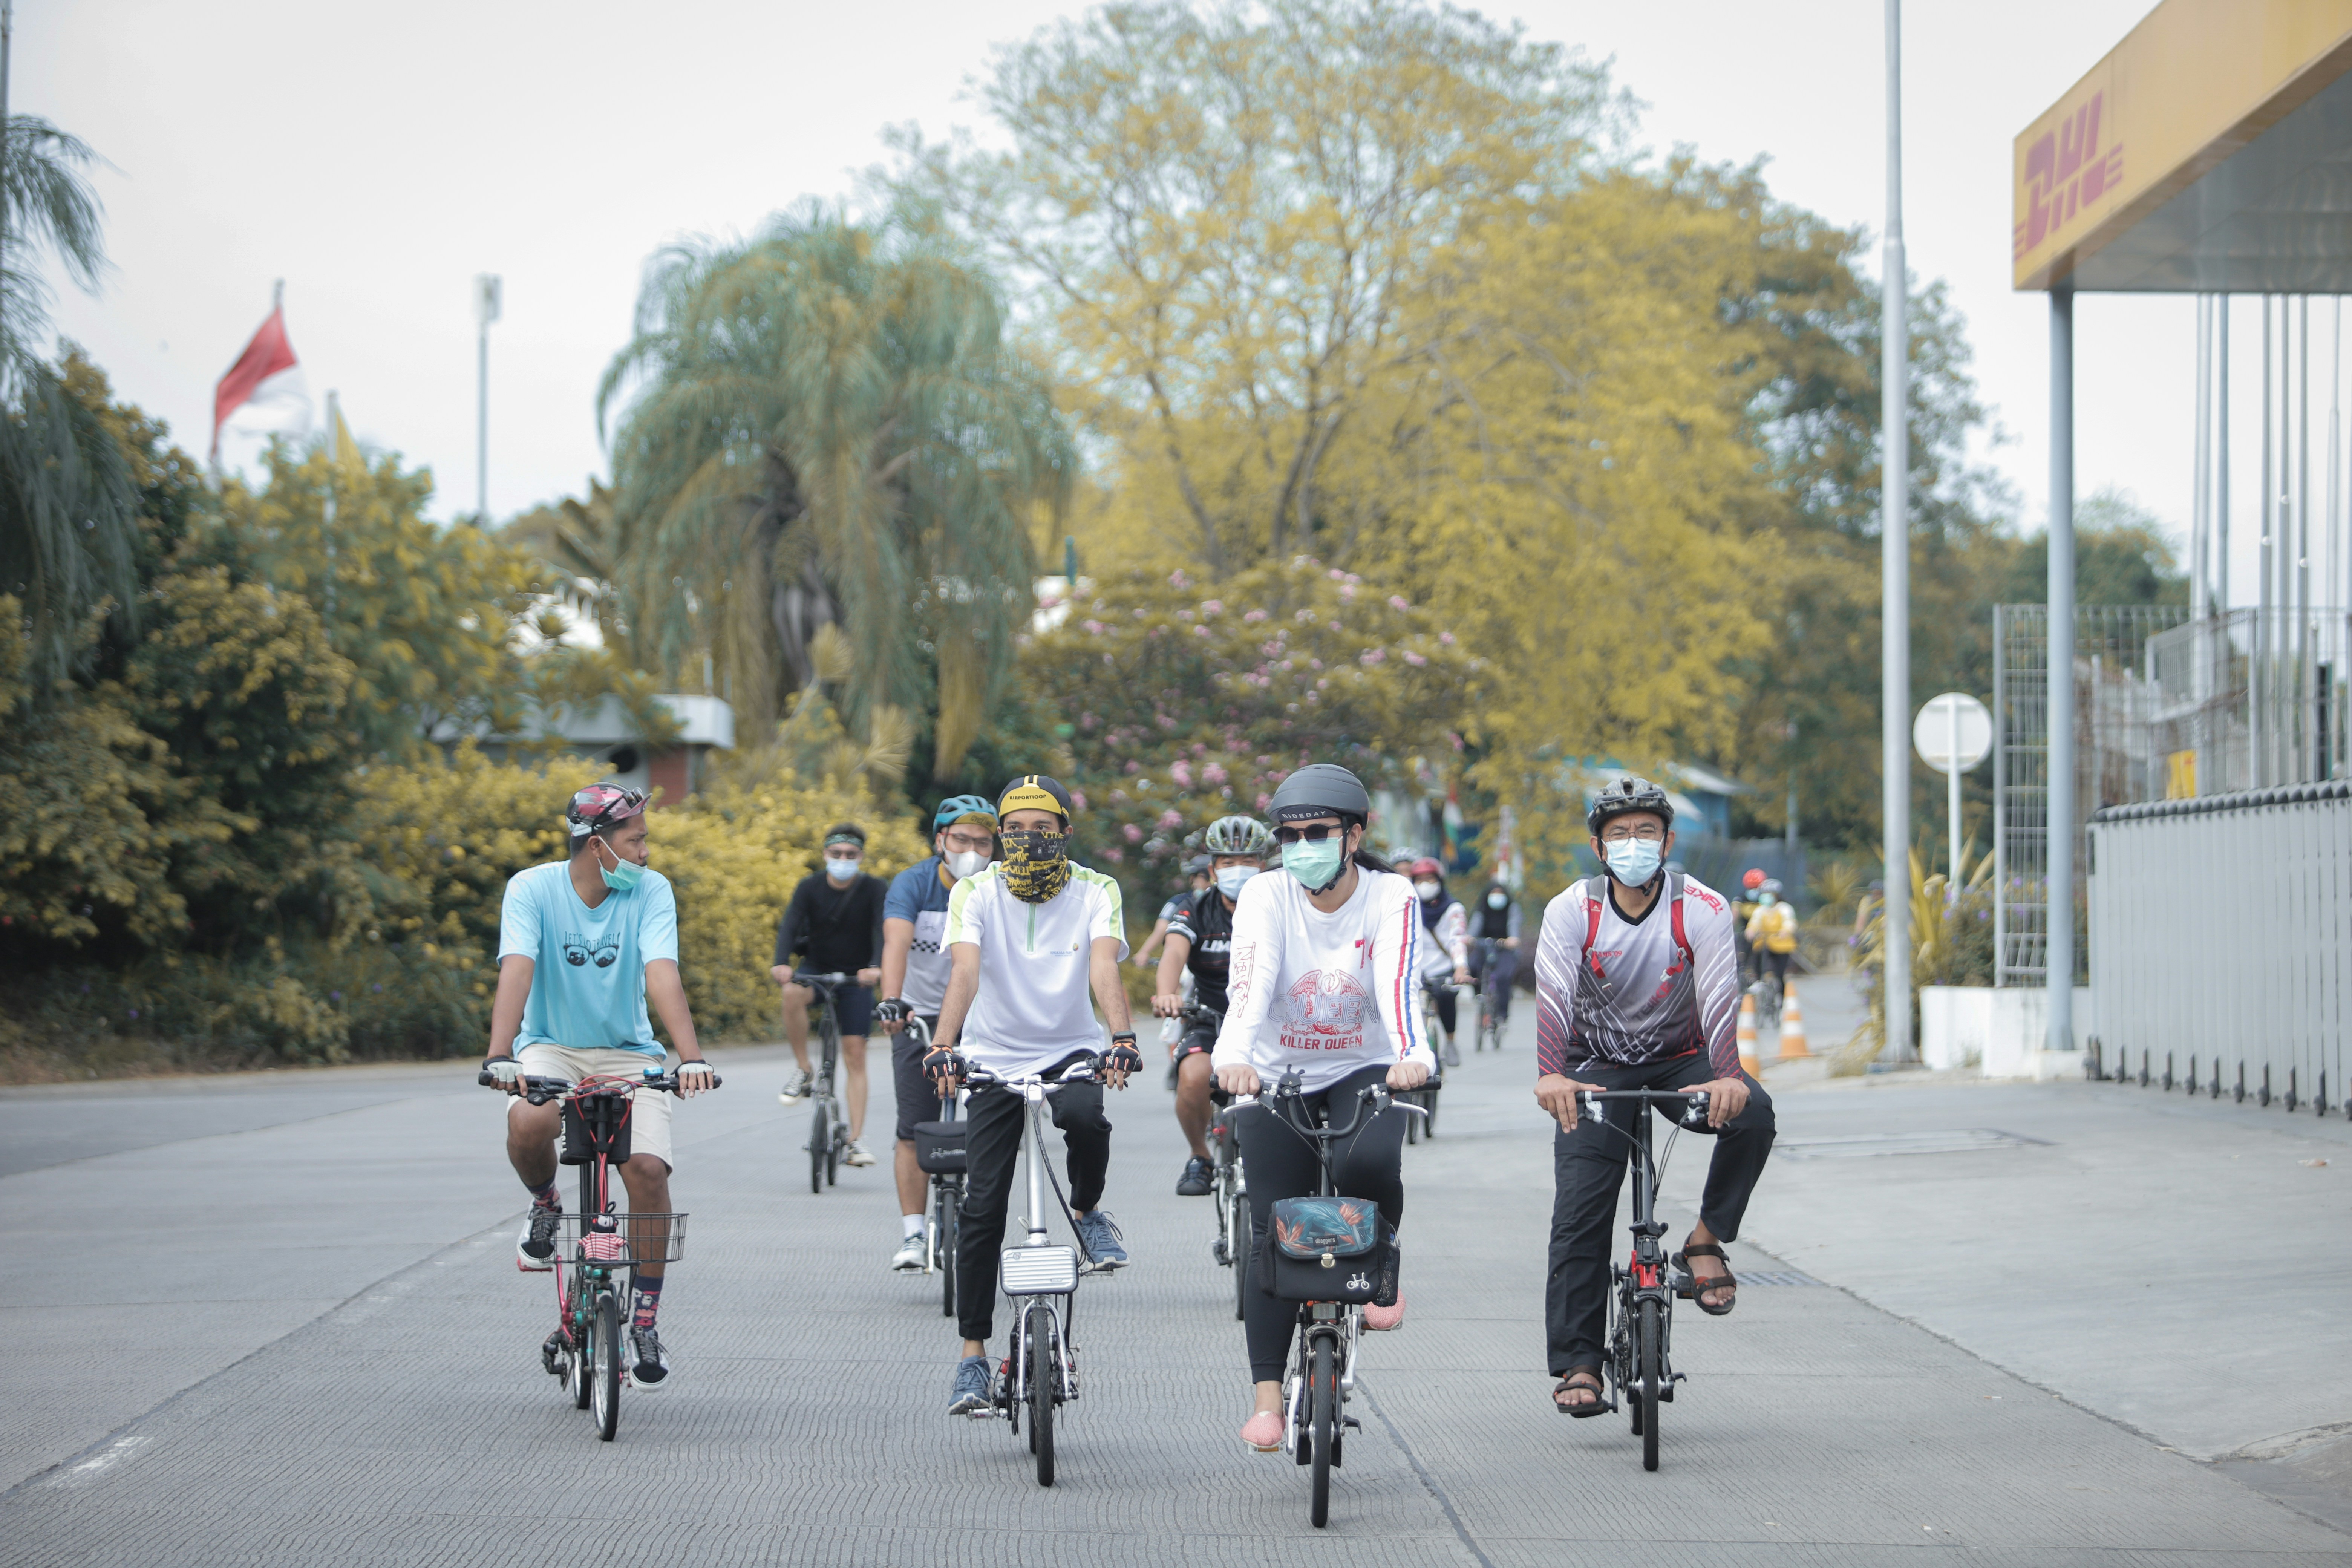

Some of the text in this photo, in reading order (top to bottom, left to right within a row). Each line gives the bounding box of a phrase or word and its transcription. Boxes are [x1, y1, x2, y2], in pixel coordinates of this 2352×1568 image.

[2023, 88, 2108, 254] DHL
[1282, 810, 1326, 819] RIDEDAY
[1267, 994, 1380, 1024] QUEEN
[1280, 1034, 1363, 1050] KILLER QUEEN
